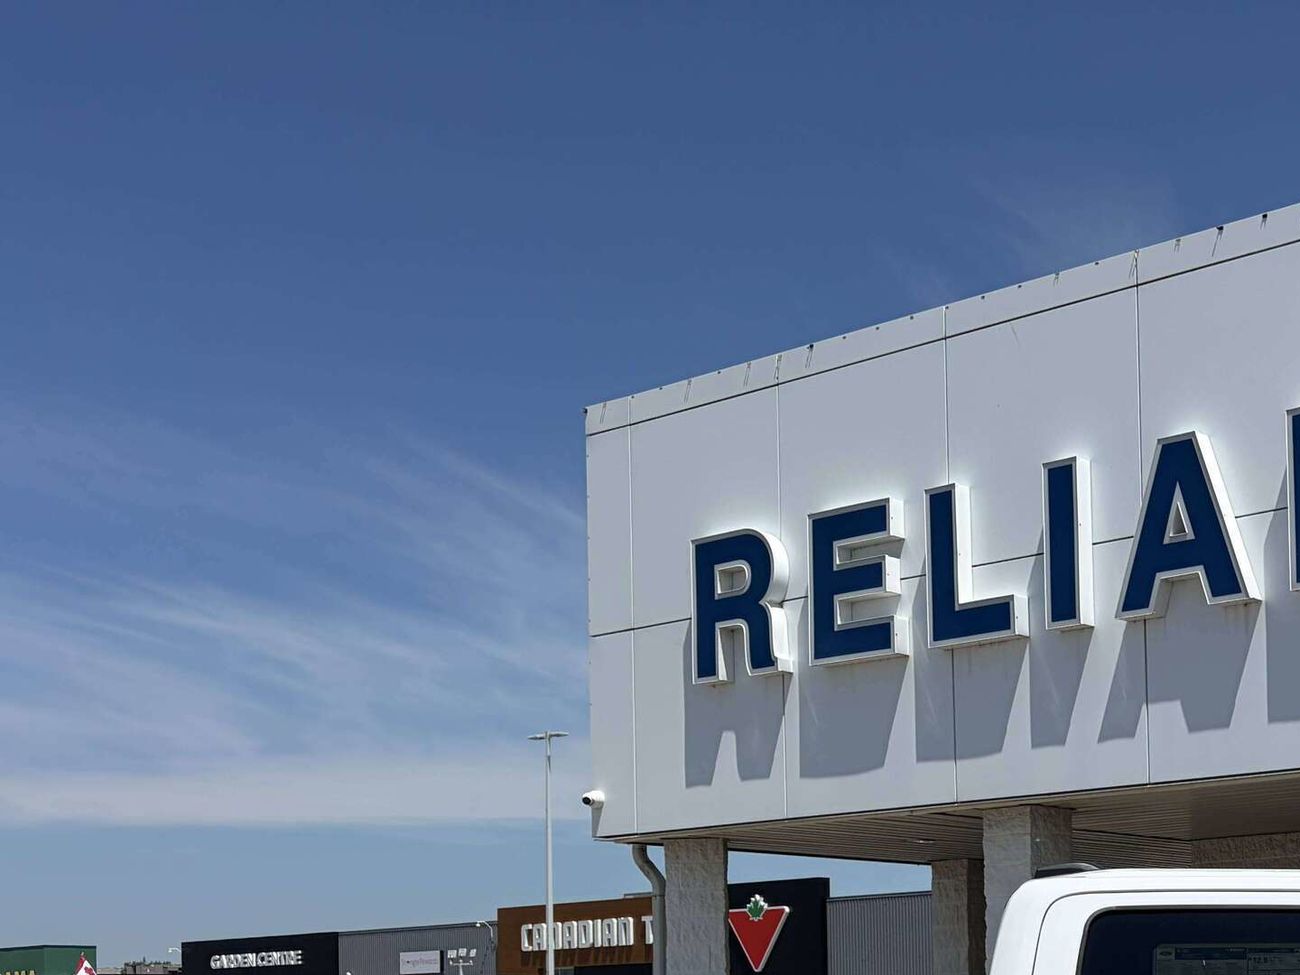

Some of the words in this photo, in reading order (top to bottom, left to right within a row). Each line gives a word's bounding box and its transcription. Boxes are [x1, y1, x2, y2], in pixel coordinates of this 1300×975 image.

[521, 916, 634, 951] CANADIAN
[210, 953, 256, 969] GARDEN
[257, 950, 302, 966] CENTRE
